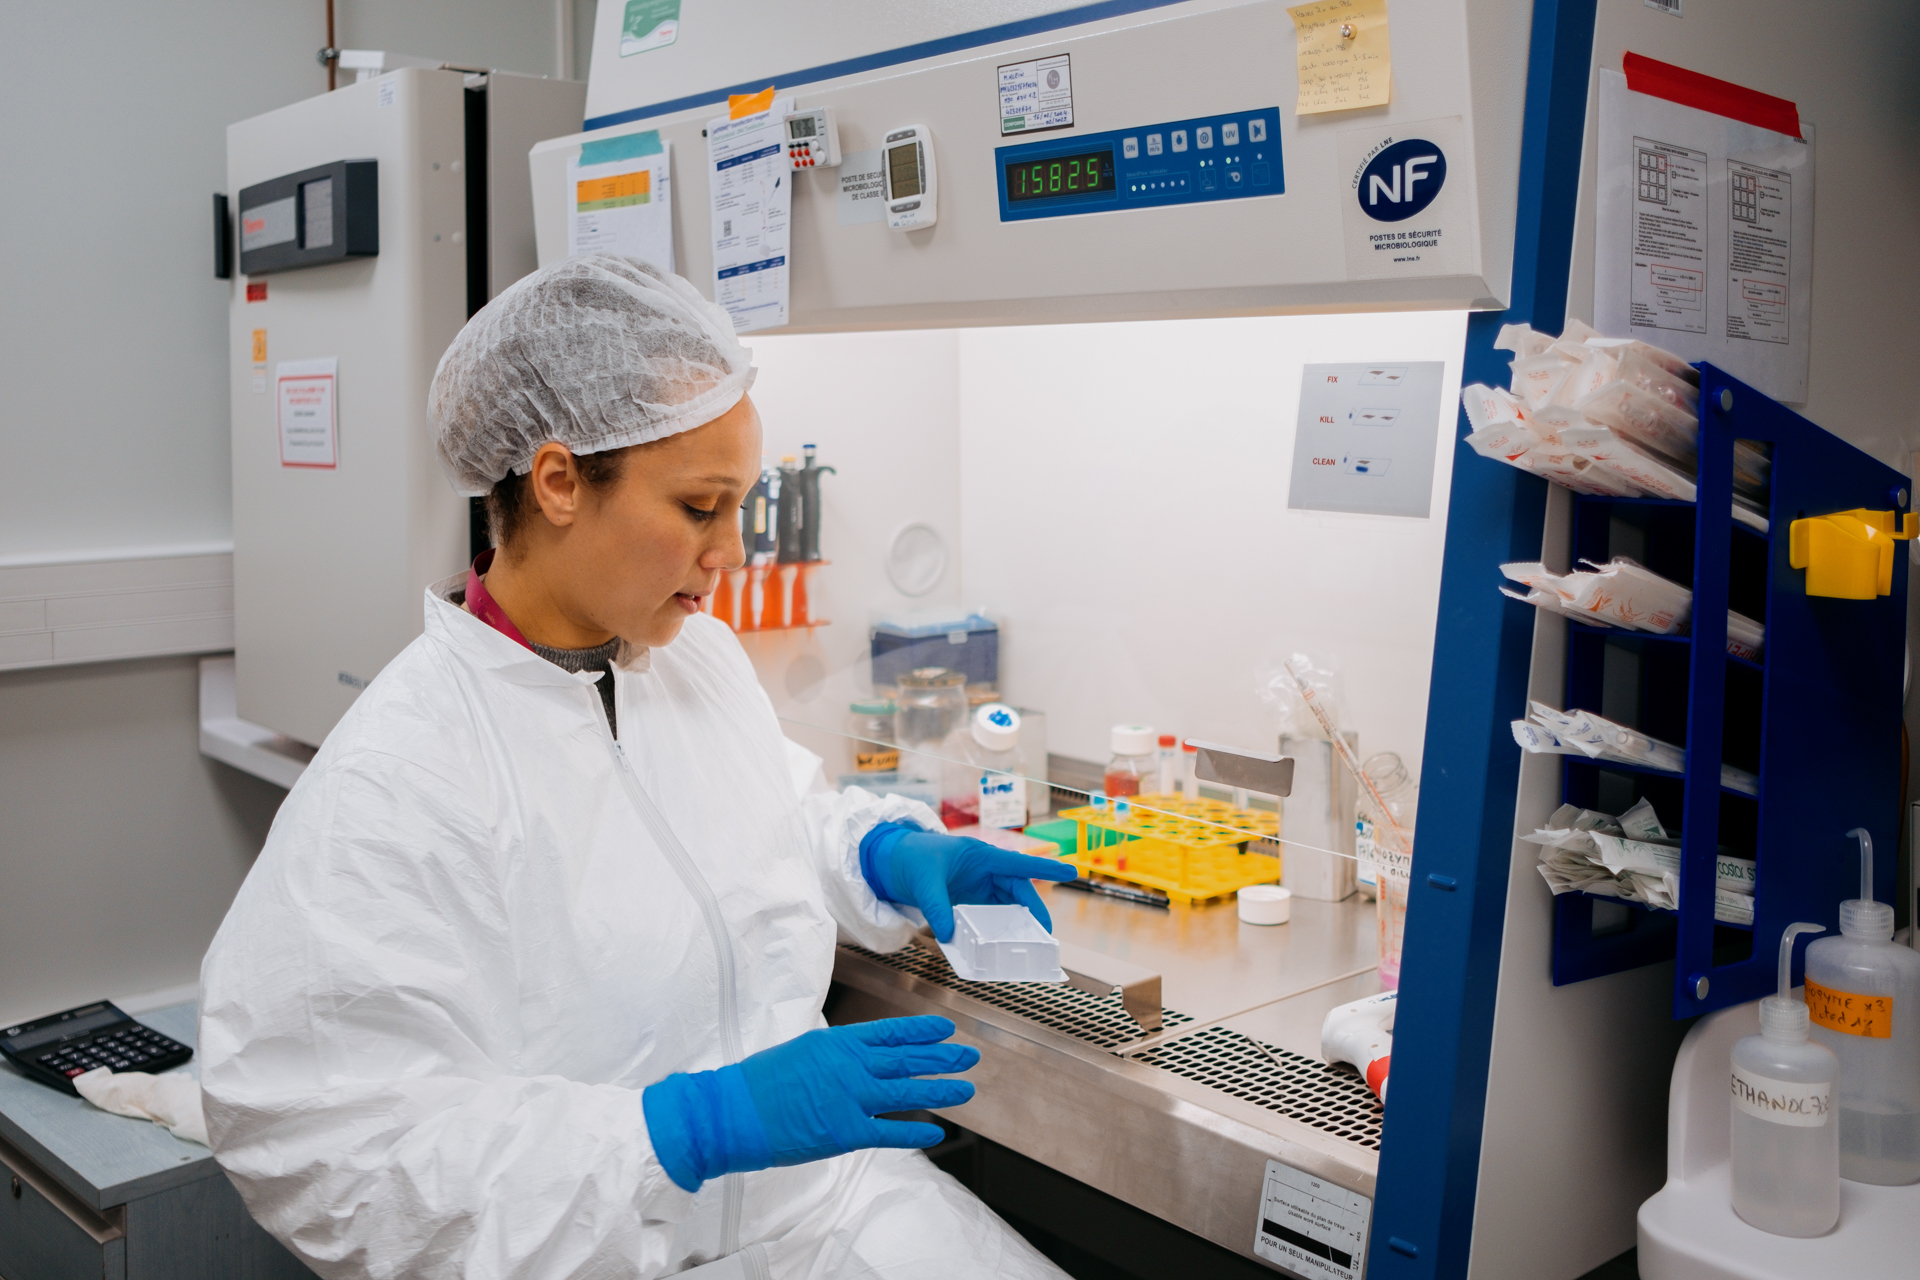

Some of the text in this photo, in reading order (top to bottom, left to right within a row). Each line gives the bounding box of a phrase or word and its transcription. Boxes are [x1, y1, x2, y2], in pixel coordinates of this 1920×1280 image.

[1225, 130, 1236, 139] UV
[1126, 144, 1136, 153] ON
[1368, 146, 1379, 159] PAR
[1379, 137, 1393, 149] LNE
[841, 175, 858, 183] POSTE
[1021, 158, 1099, 194] 15825
[1369, 155, 1438, 206] NF
[860, 191, 879, 200] CLASSE
[1369, 228, 1442, 242] POSTES DE SÉCURITÉ
[1374, 239, 1438, 251] MICROBIOLOGIQUE
[1312, 457, 1336, 466] CLEAN
[1731, 1074, 1811, 1115] ETHANOL
[1310, 1181, 1320, 1189] 1200
[1273, 1196, 1290, 1207] Surface
[1290, 1204, 1310, 1216] utilisable
[1316, 1214, 1327, 1223] plan
[1288, 1210, 1331, 1232] Usable work surface
[1261, 1236, 1278, 1249] POUR
[1278, 1244, 1287, 1253] UN
[1288, 1248, 1304, 1260] SEUL
